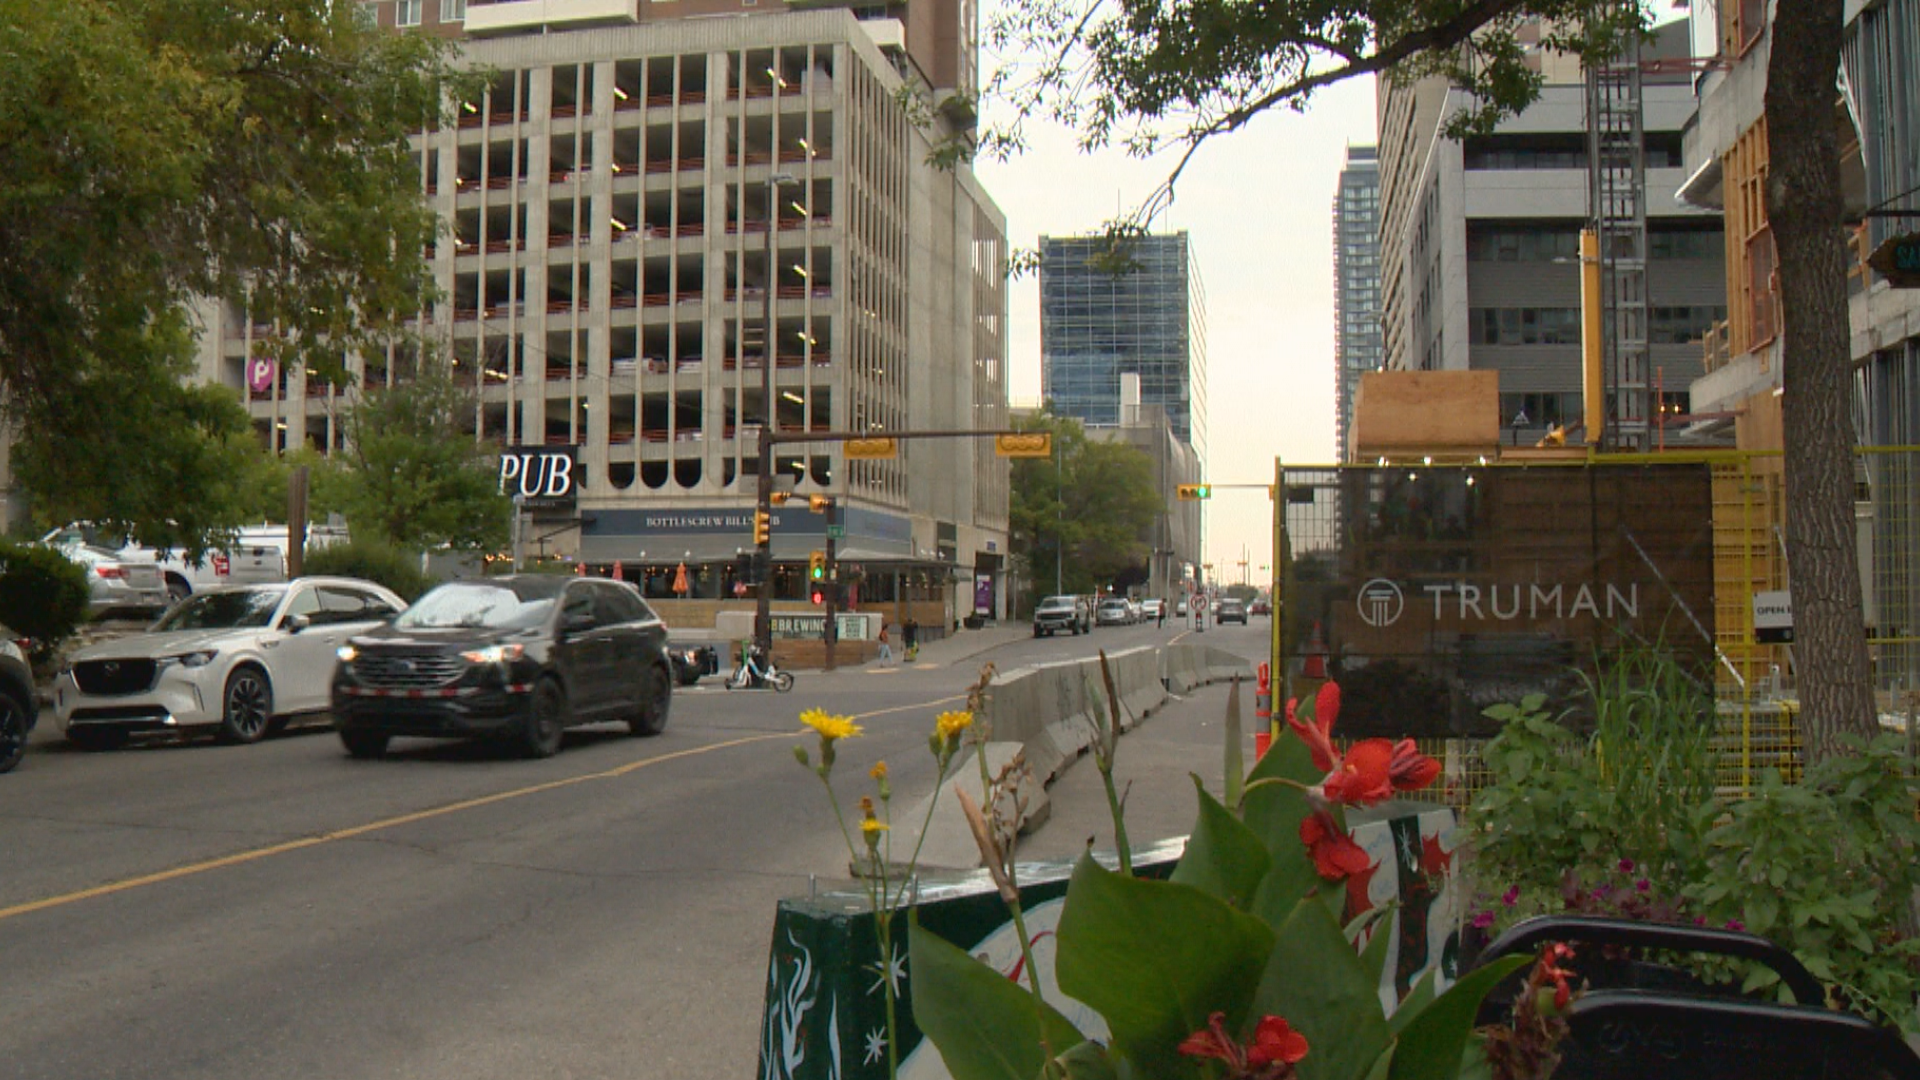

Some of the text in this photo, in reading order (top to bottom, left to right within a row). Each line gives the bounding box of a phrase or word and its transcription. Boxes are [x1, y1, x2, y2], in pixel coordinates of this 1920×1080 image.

[497, 453, 573, 497] PUB
[646, 516, 723, 528] BOTTLESCREW
[1423, 582, 1639, 620] TRUMAN
[1756, 606, 1785, 616] OPEN
